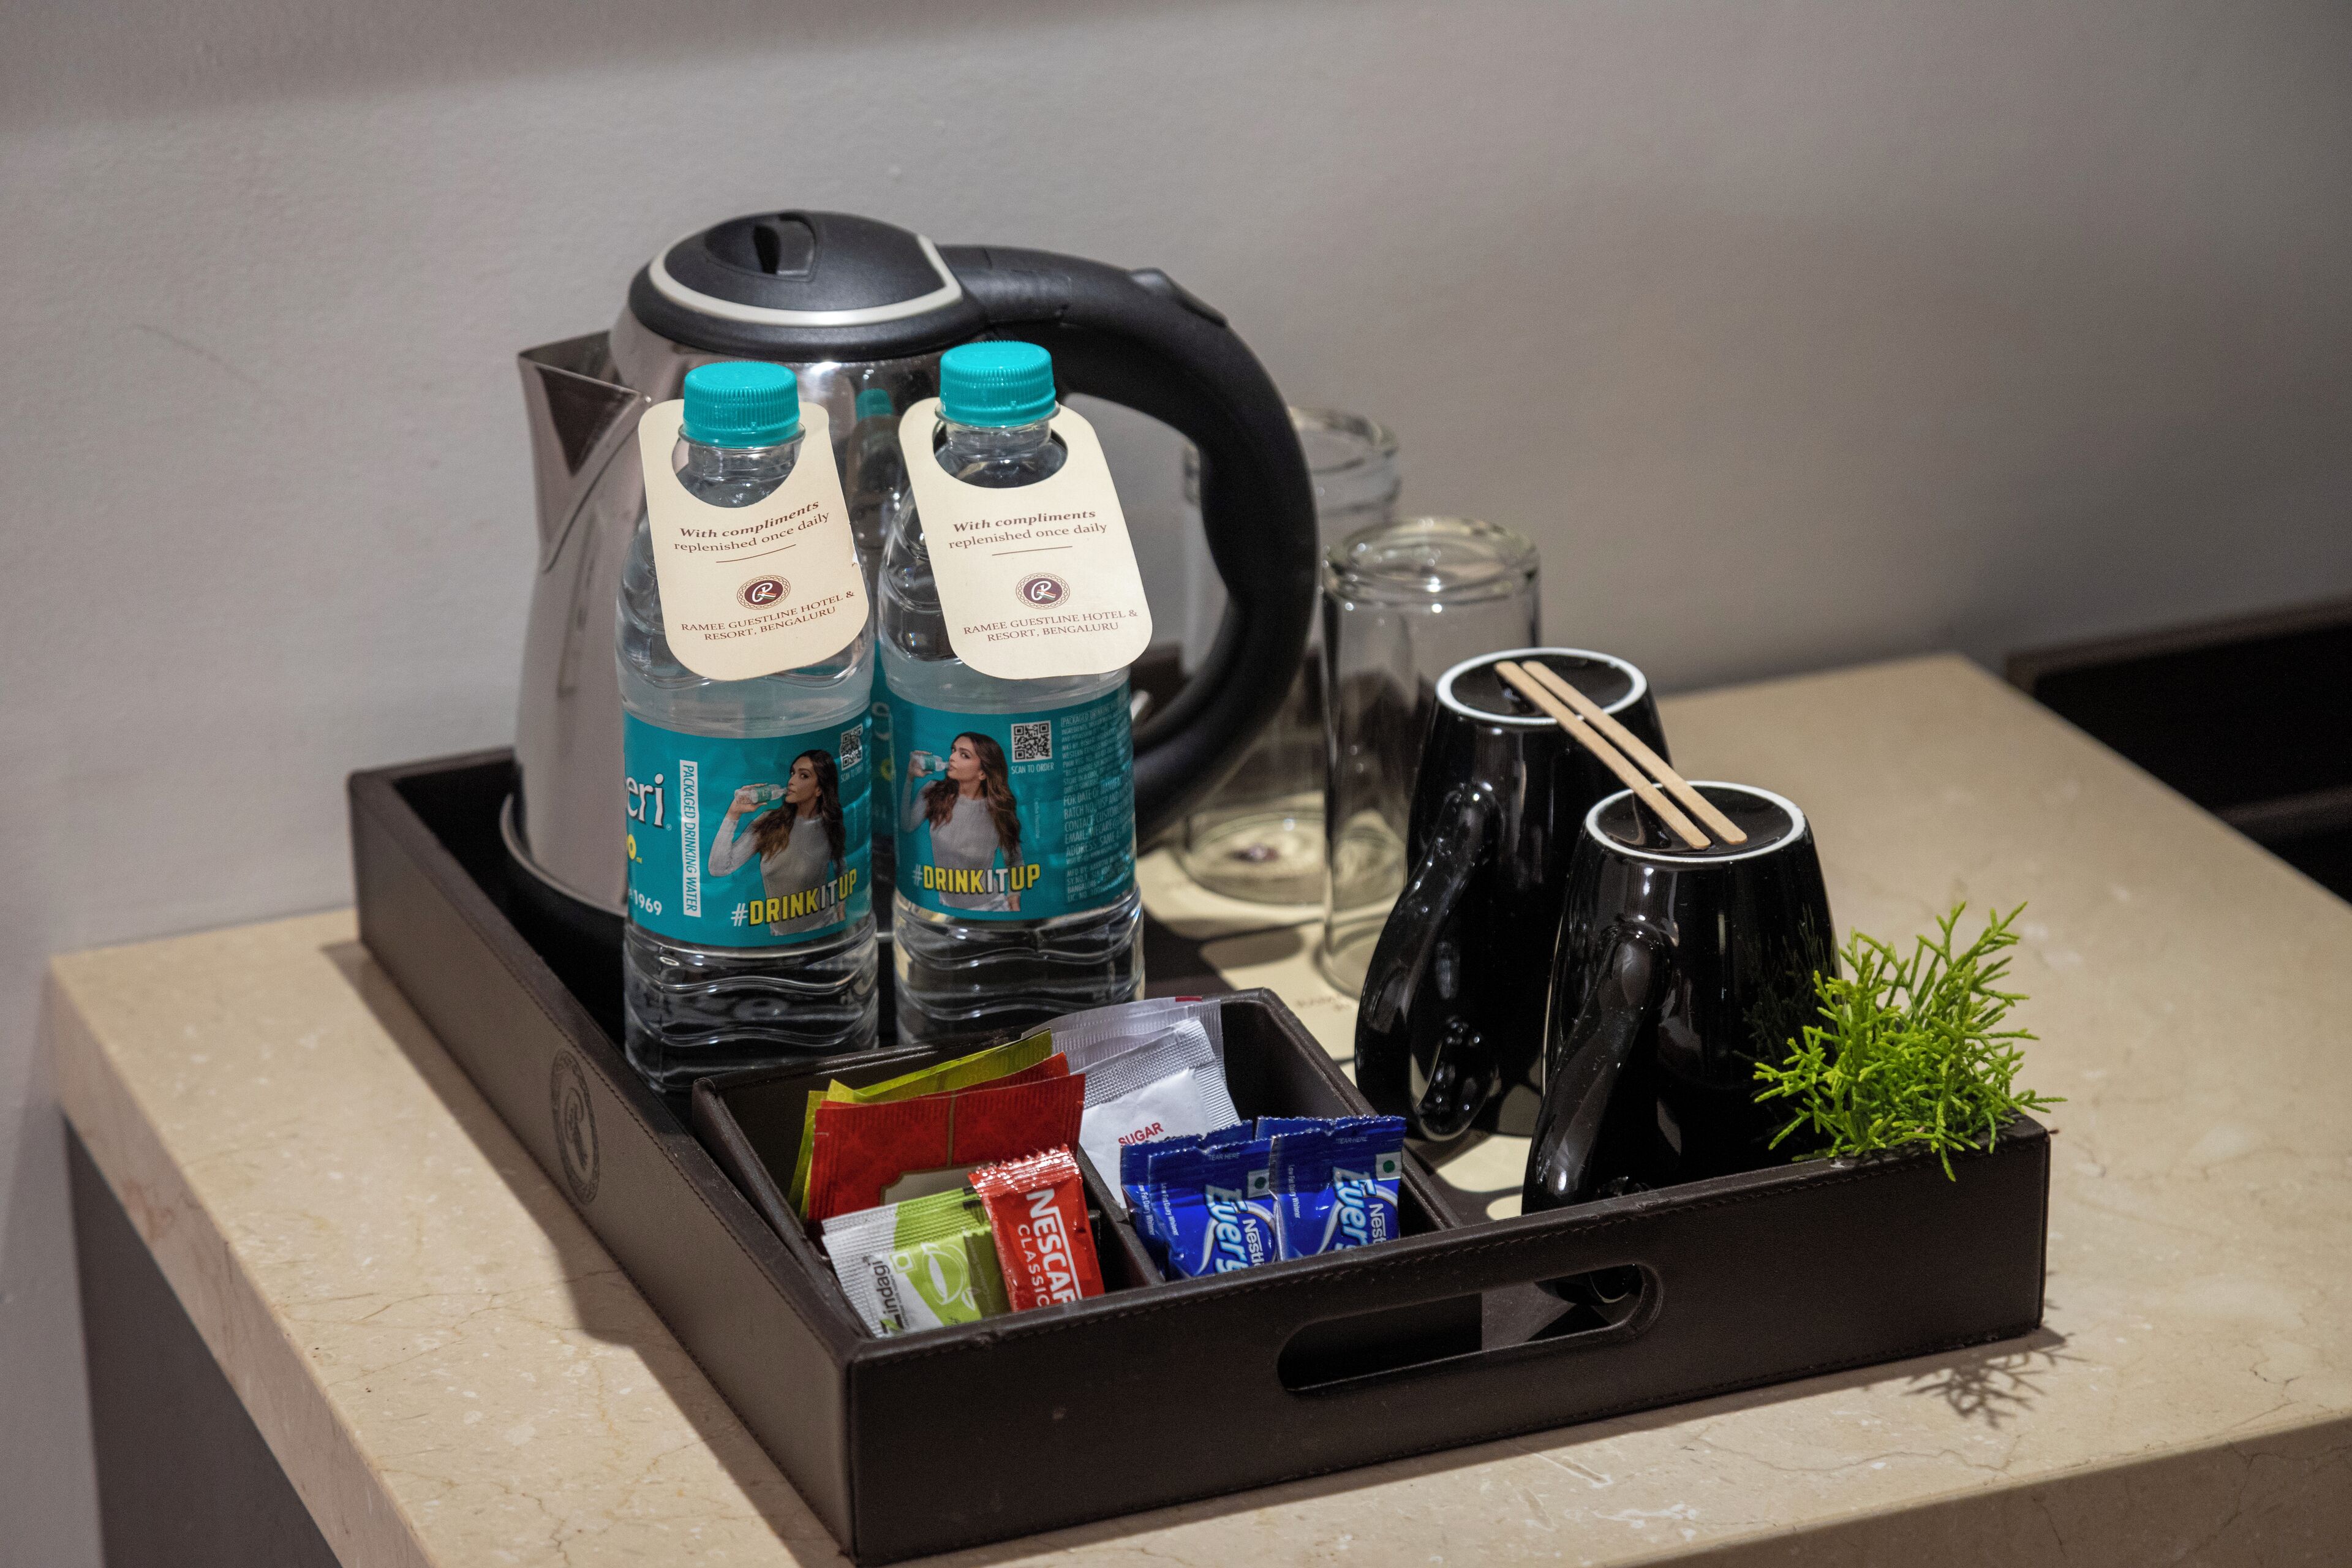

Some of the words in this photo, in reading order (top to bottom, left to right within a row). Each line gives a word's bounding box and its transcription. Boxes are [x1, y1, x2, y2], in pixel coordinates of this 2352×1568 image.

[674, 537, 757, 553] replenished
[761, 528, 794, 543] once
[798, 512, 829, 530] daily
[679, 528, 717, 537] With
[722, 501, 819, 537] compliments
[949, 529, 1031, 549] replenished
[1036, 527, 1069, 537] once
[1074, 522, 1107, 533] daily
[954, 519, 991, 532] With
[995, 511, 1096, 527] compliments
[704, 628, 757, 641] RESORT,
[760, 606, 835, 633] BENGALURU
[728, 608, 798, 628] GUESTLINE
[801, 595, 843, 612] HOTEL
[963, 622, 1008, 635] RAMEE
[1010, 614, 1079, 628] GUESTLINE
[1083, 611, 1126, 621] HOTEL
[987, 629, 1039, 642] RESORT,
[1043, 622, 1119, 635] BENGALURU
[1011, 765, 1026, 775] SCAN
[1027, 764, 1035, 773] TO
[1036, 762, 1054, 772] ORDER
[683, 764, 695, 818] PACKAGED
[1064, 805, 1084, 820] BATCH
[684, 823, 696, 873] DRINKING
[685, 876, 698, 911] WATER
[912, 863, 1041, 894] #DRINKITUP
[633, 890, 662, 916] 1969
[731, 869, 857, 926] #DRINKITUP
[1118, 1122, 1164, 1145] SUGAR
[1332, 1166, 1376, 1250] Ever
[1242, 1218, 1265, 1267] Nestl
[1017, 1224, 1050, 1307] CLASSIC
